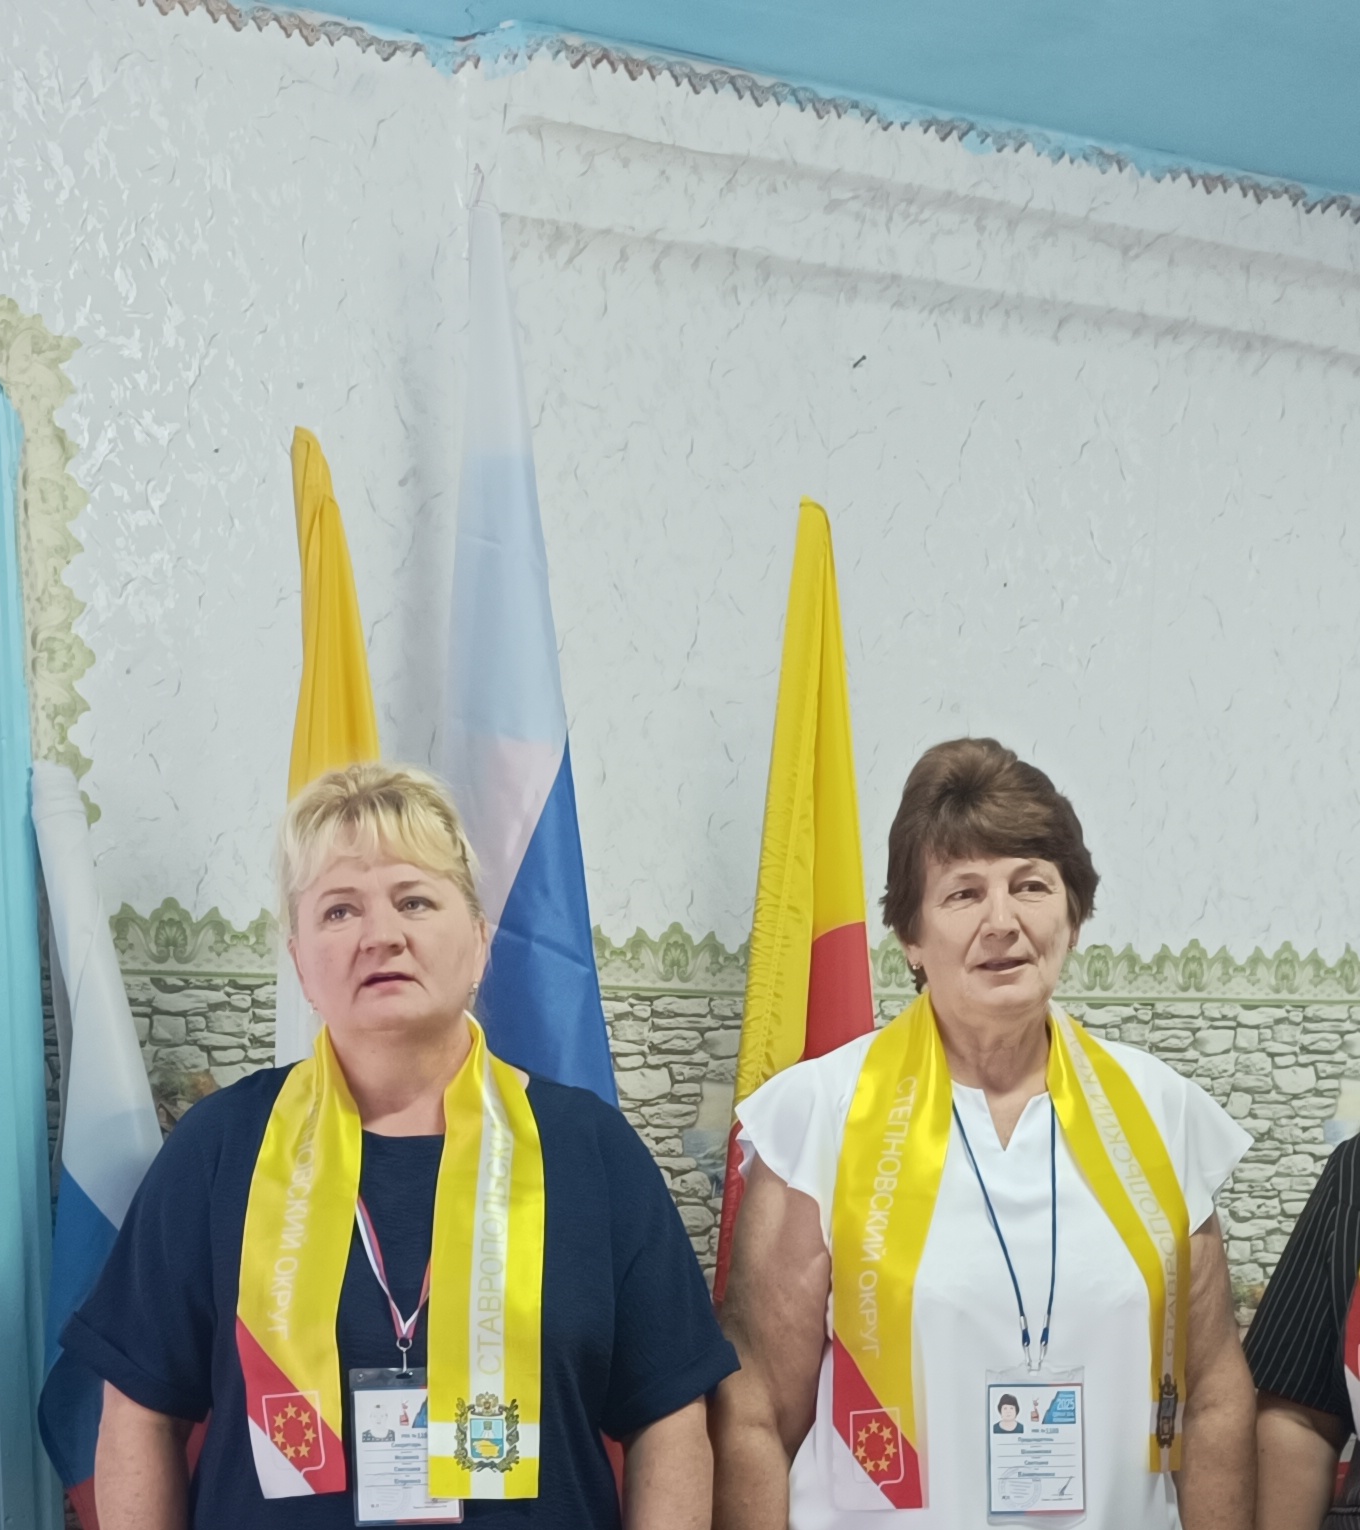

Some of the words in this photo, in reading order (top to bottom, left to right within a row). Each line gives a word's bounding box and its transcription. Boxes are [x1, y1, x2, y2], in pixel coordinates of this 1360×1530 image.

[860, 1075, 918, 1262] СТЕПНОВСКИЙ
[267, 1256, 298, 1341] ОКРУГ
[858, 1269, 880, 1359] ОКРУГ
